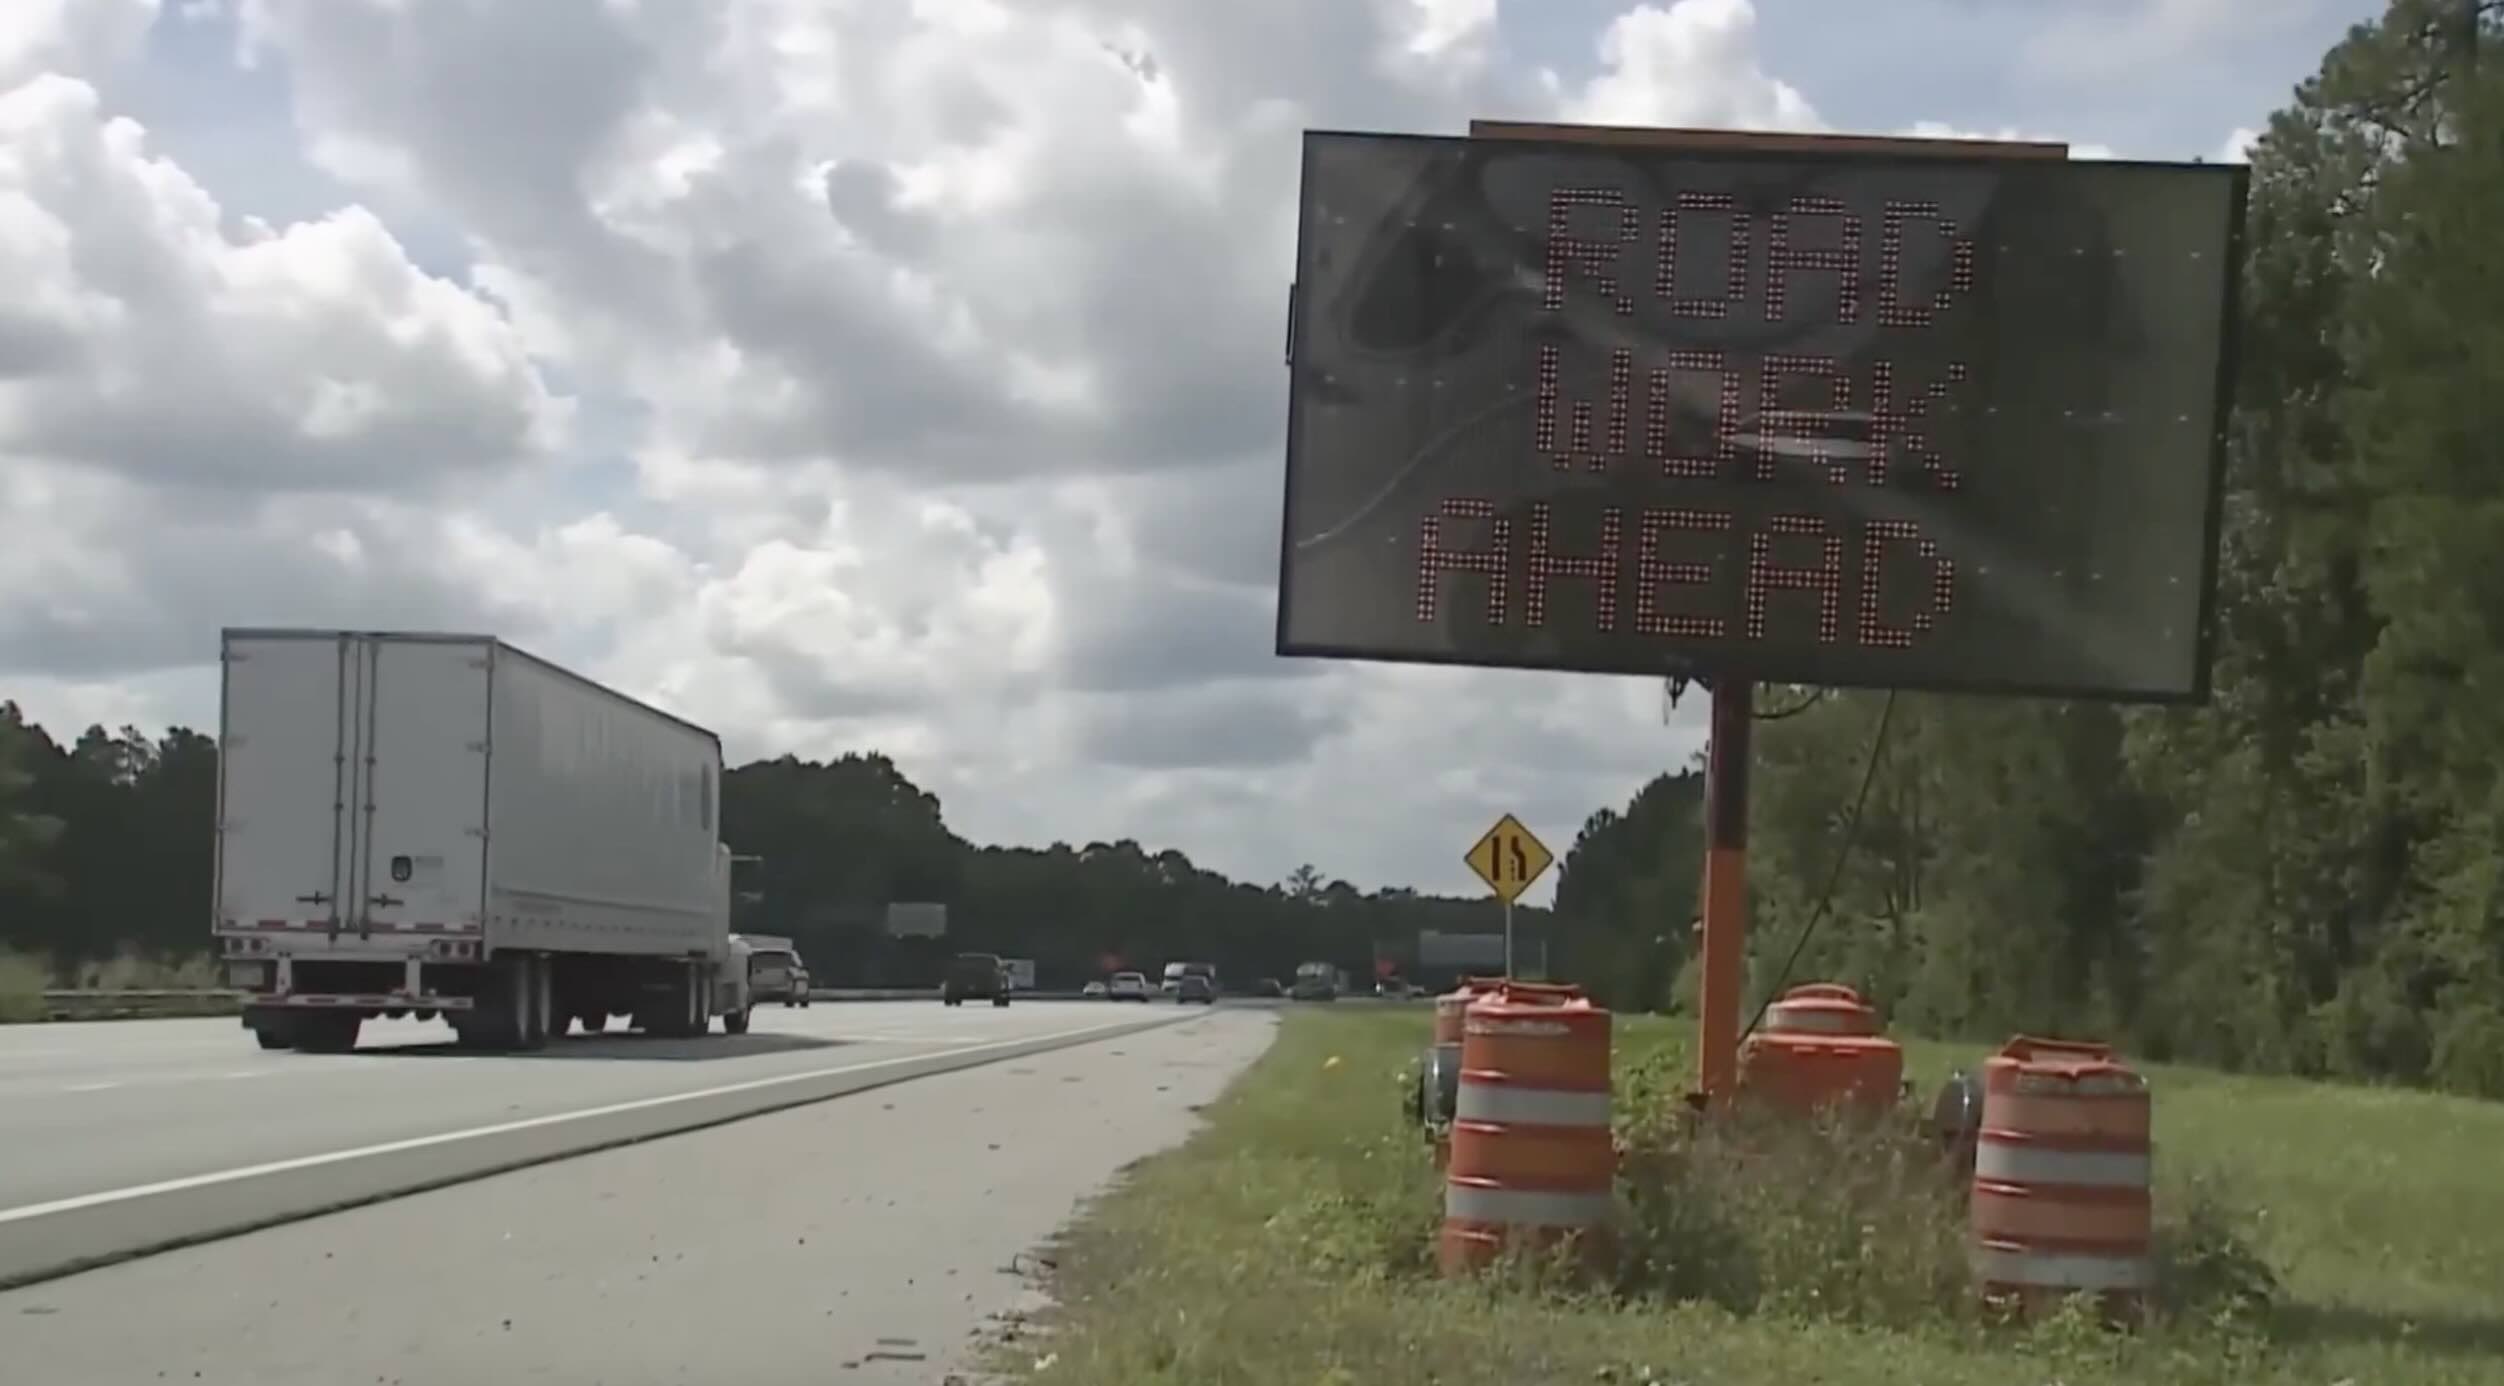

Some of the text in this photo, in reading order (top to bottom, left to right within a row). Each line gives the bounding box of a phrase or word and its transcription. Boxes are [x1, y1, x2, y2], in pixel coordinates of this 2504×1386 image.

[1545, 188, 1973, 327] ROAD
[1538, 345, 1965, 488] WORK
[1417, 499, 1953, 646] AHEAD
